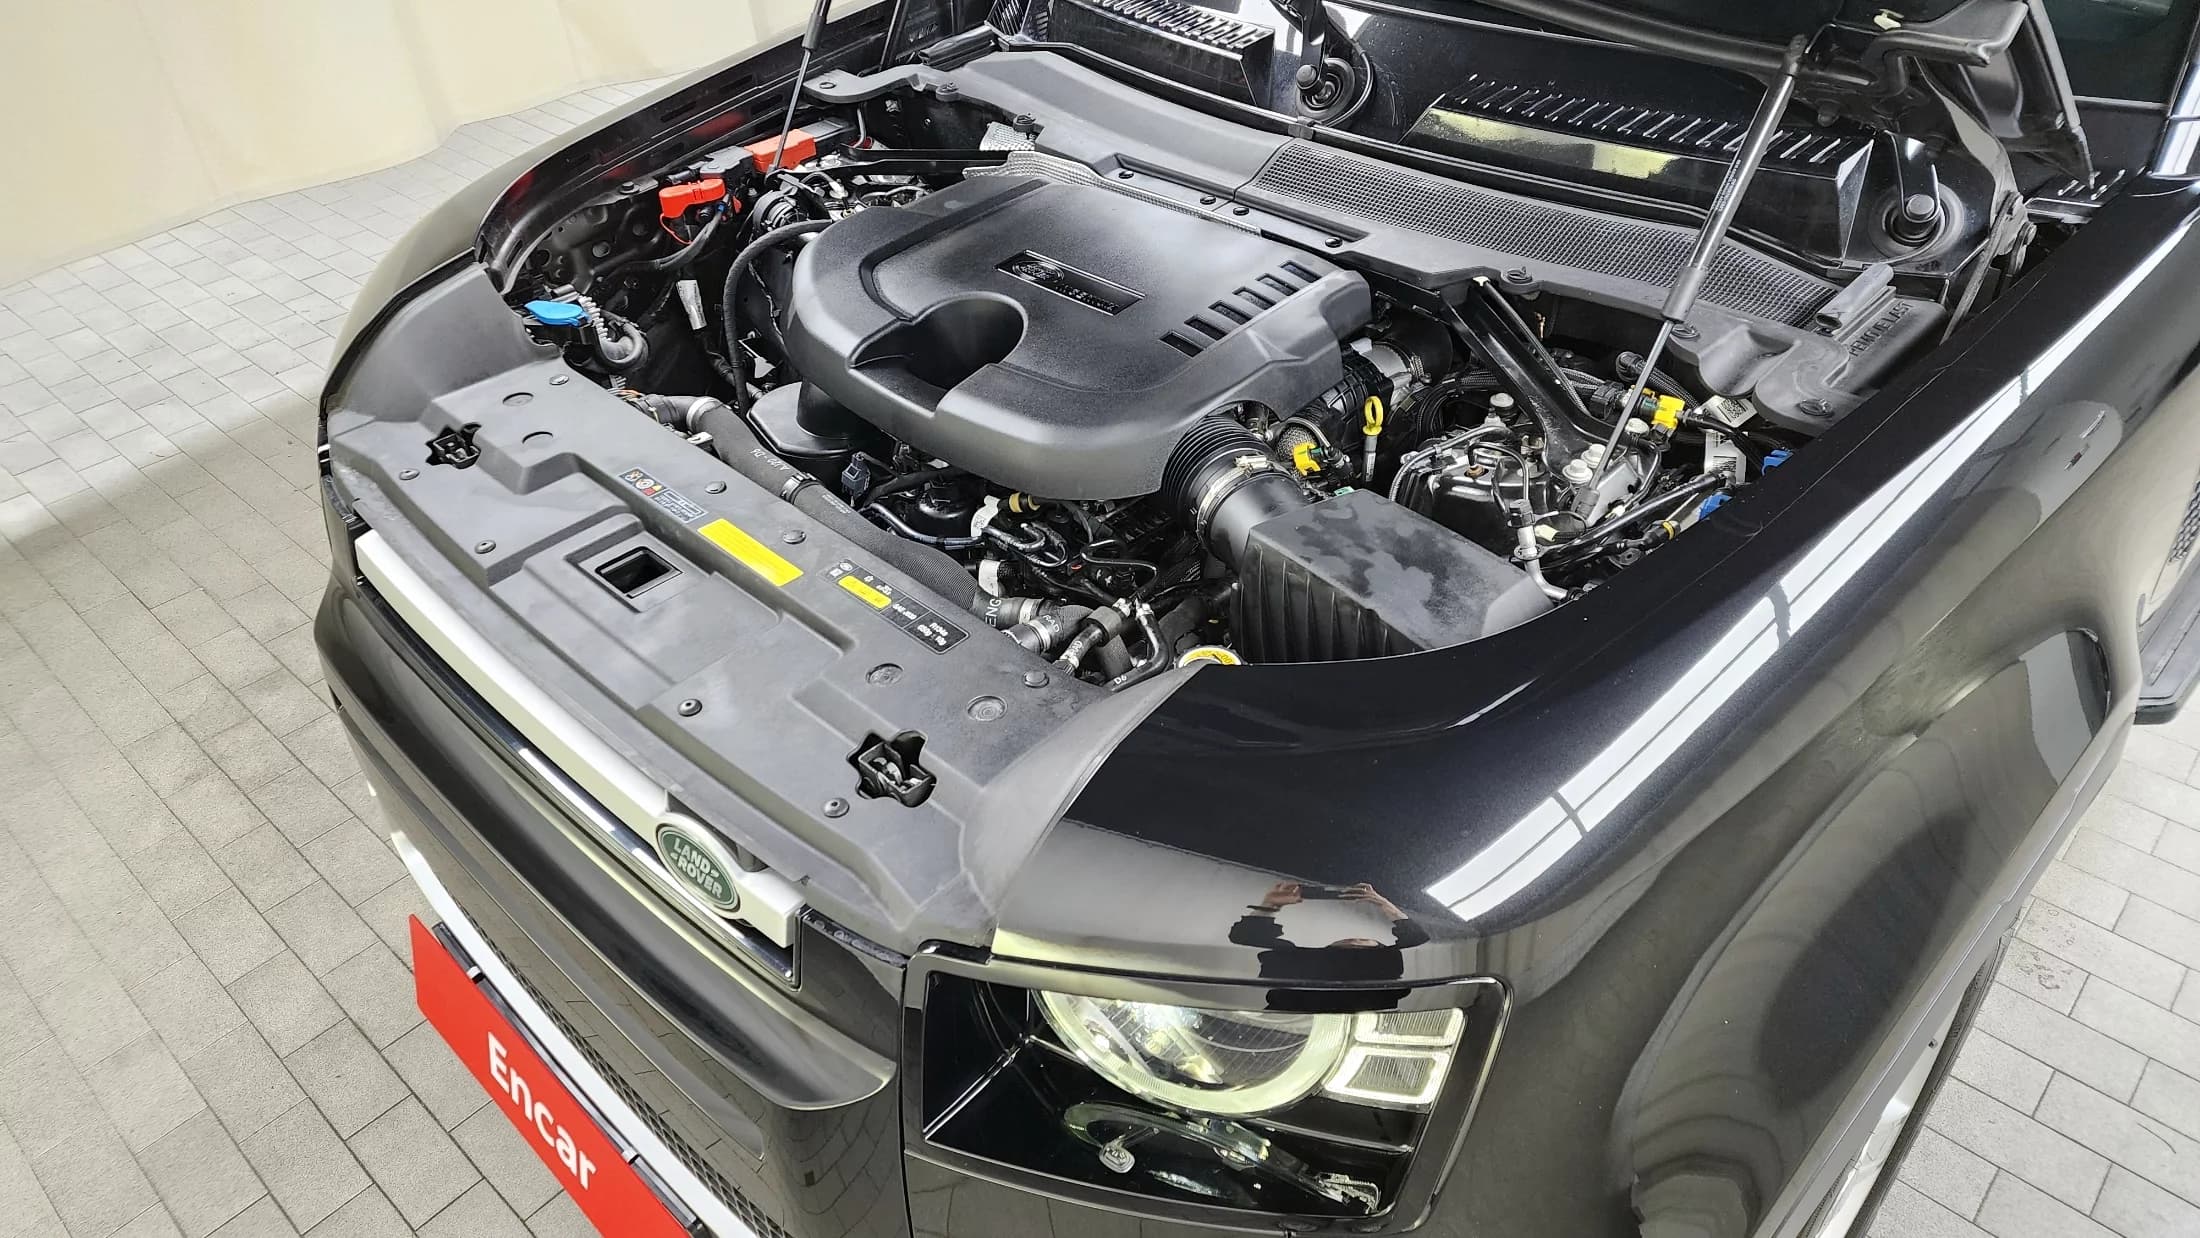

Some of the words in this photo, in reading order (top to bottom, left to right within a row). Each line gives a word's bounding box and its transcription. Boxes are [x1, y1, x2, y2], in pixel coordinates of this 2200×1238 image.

[985, 598, 1001, 627] ENG
[1042, 614, 1061, 633] RAD
[673, 837, 711, 874] LAND
[677, 855, 723, 898] ROVER
[487, 1031, 596, 1190] Encar
